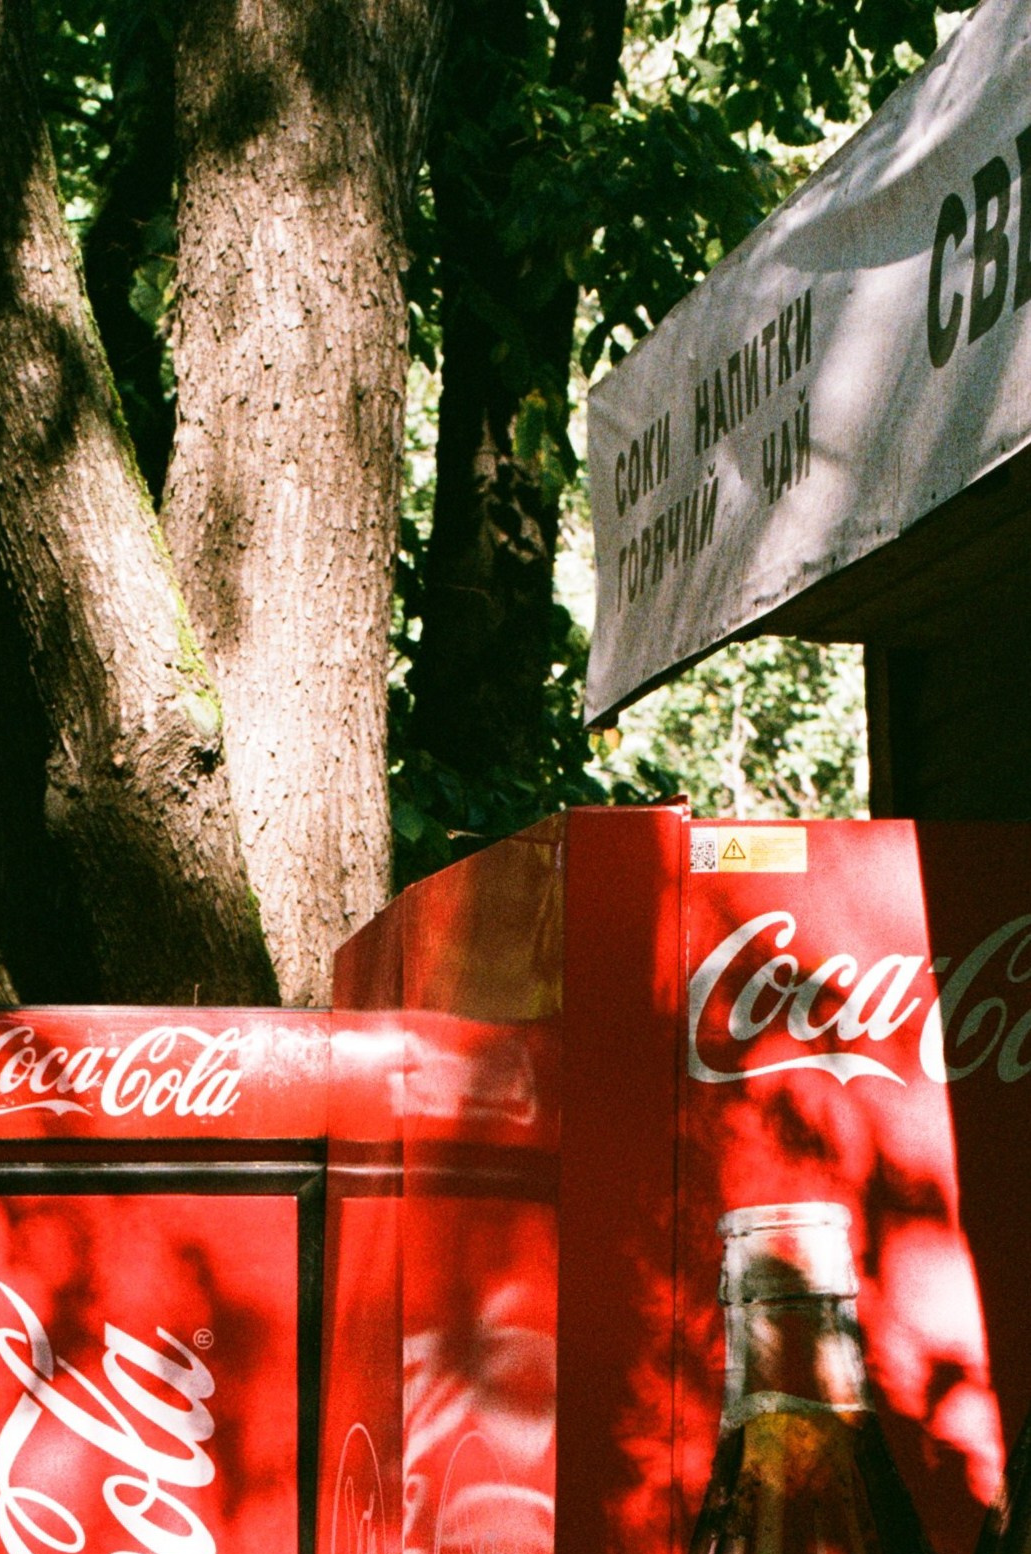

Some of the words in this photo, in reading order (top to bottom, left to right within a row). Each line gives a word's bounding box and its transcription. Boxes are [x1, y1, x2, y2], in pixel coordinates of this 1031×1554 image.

[615, 410, 670, 518] СОКИ
[695, 287, 812, 457] НАПИТКИ
[617, 462, 719, 613] ГОРЯЧИЙ
[762, 385, 811, 506] ЧАЙ
